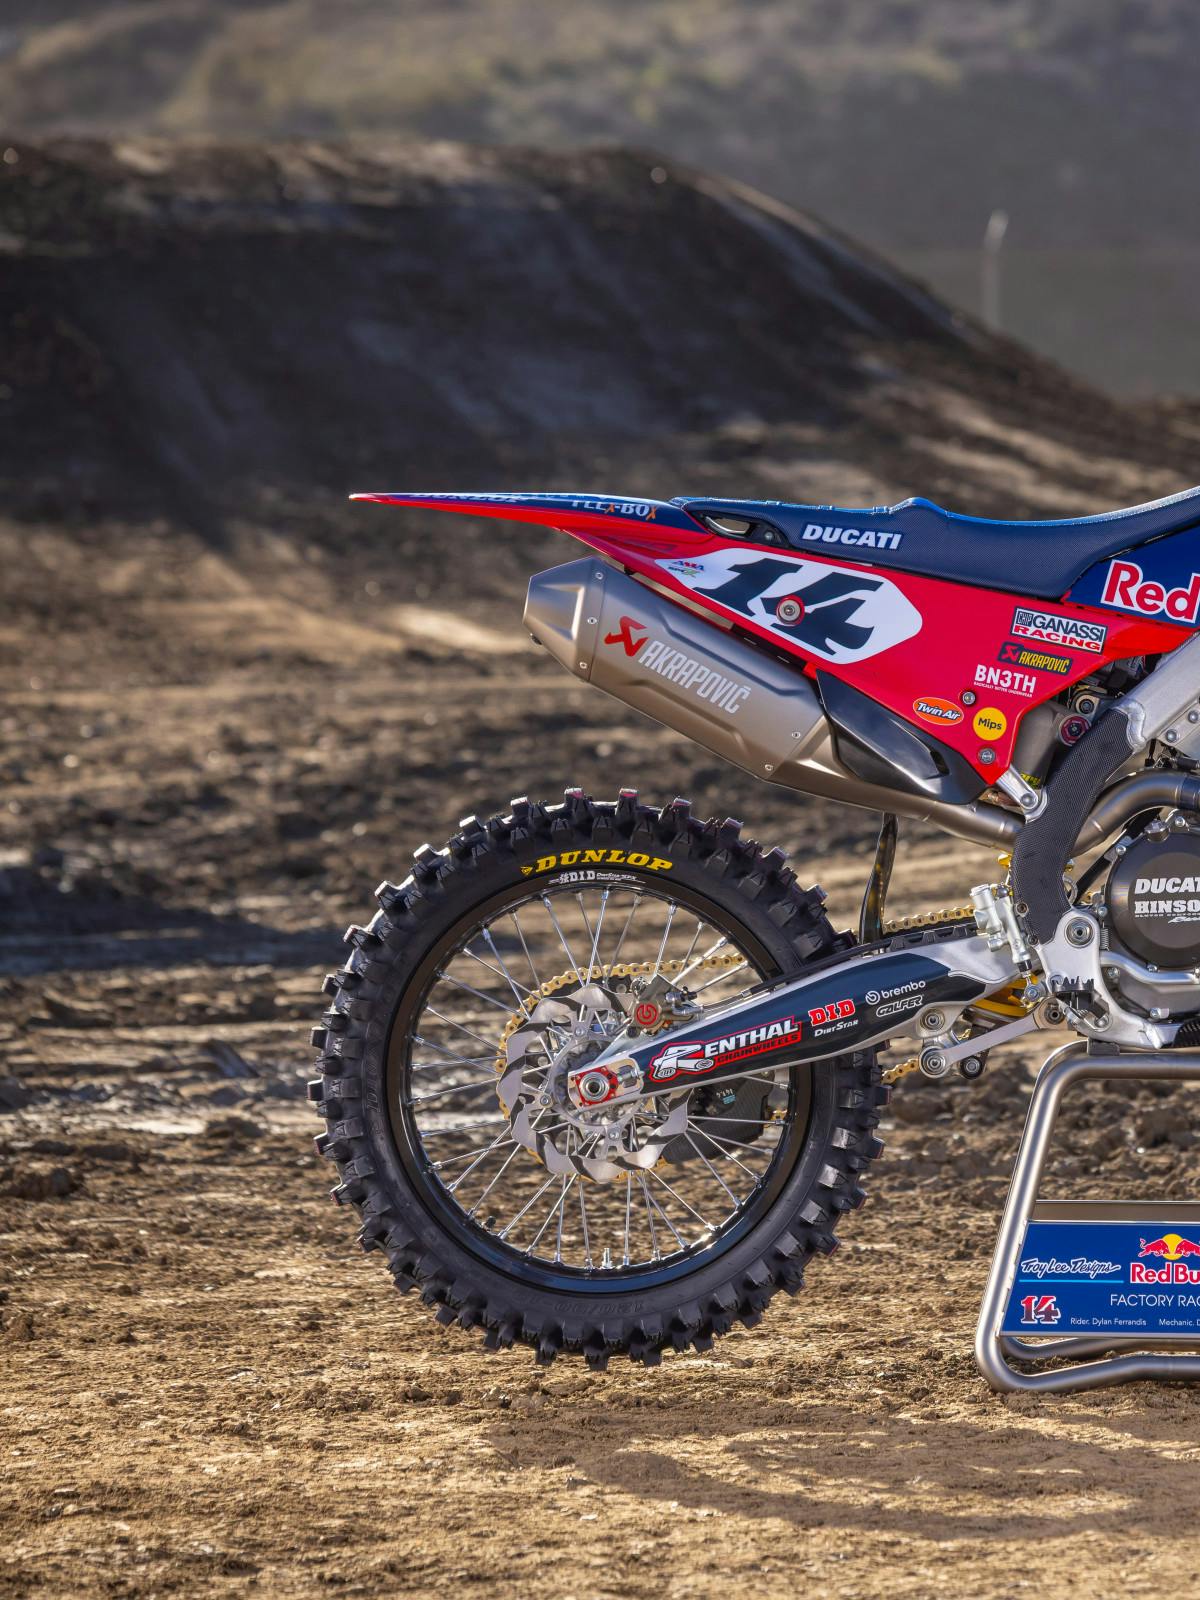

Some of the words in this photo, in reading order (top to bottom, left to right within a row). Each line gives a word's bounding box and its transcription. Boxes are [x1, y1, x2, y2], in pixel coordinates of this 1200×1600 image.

[802, 524, 902, 550] DUCATI
[692, 558, 885, 656] 14
[1013, 625, 1102, 651] RACING
[1033, 614, 1104, 642] GANASSI
[974, 664, 1036, 694] BN3TH
[917, 702, 943, 716] Twin
[942, 709, 961, 721] Air
[978, 717, 1002, 730] Mips
[535, 849, 673, 873] DUNLOP
[881, 980, 926, 999] brembo
[876, 995, 923, 1018] GALFER
[1021, 1258, 1049, 1279] Troy
[1047, 1258, 1070, 1273] Lee
[1070, 1258, 1121, 1279] Designs
[1130, 1262, 1172, 1285] Red
[1020, 1295, 1061, 1325] 14
[1110, 1295, 1174, 1307] FACTORY
[1092, 1317, 1112, 1327] Dylan
[1114, 1317, 1147, 1326] Ferrandis
